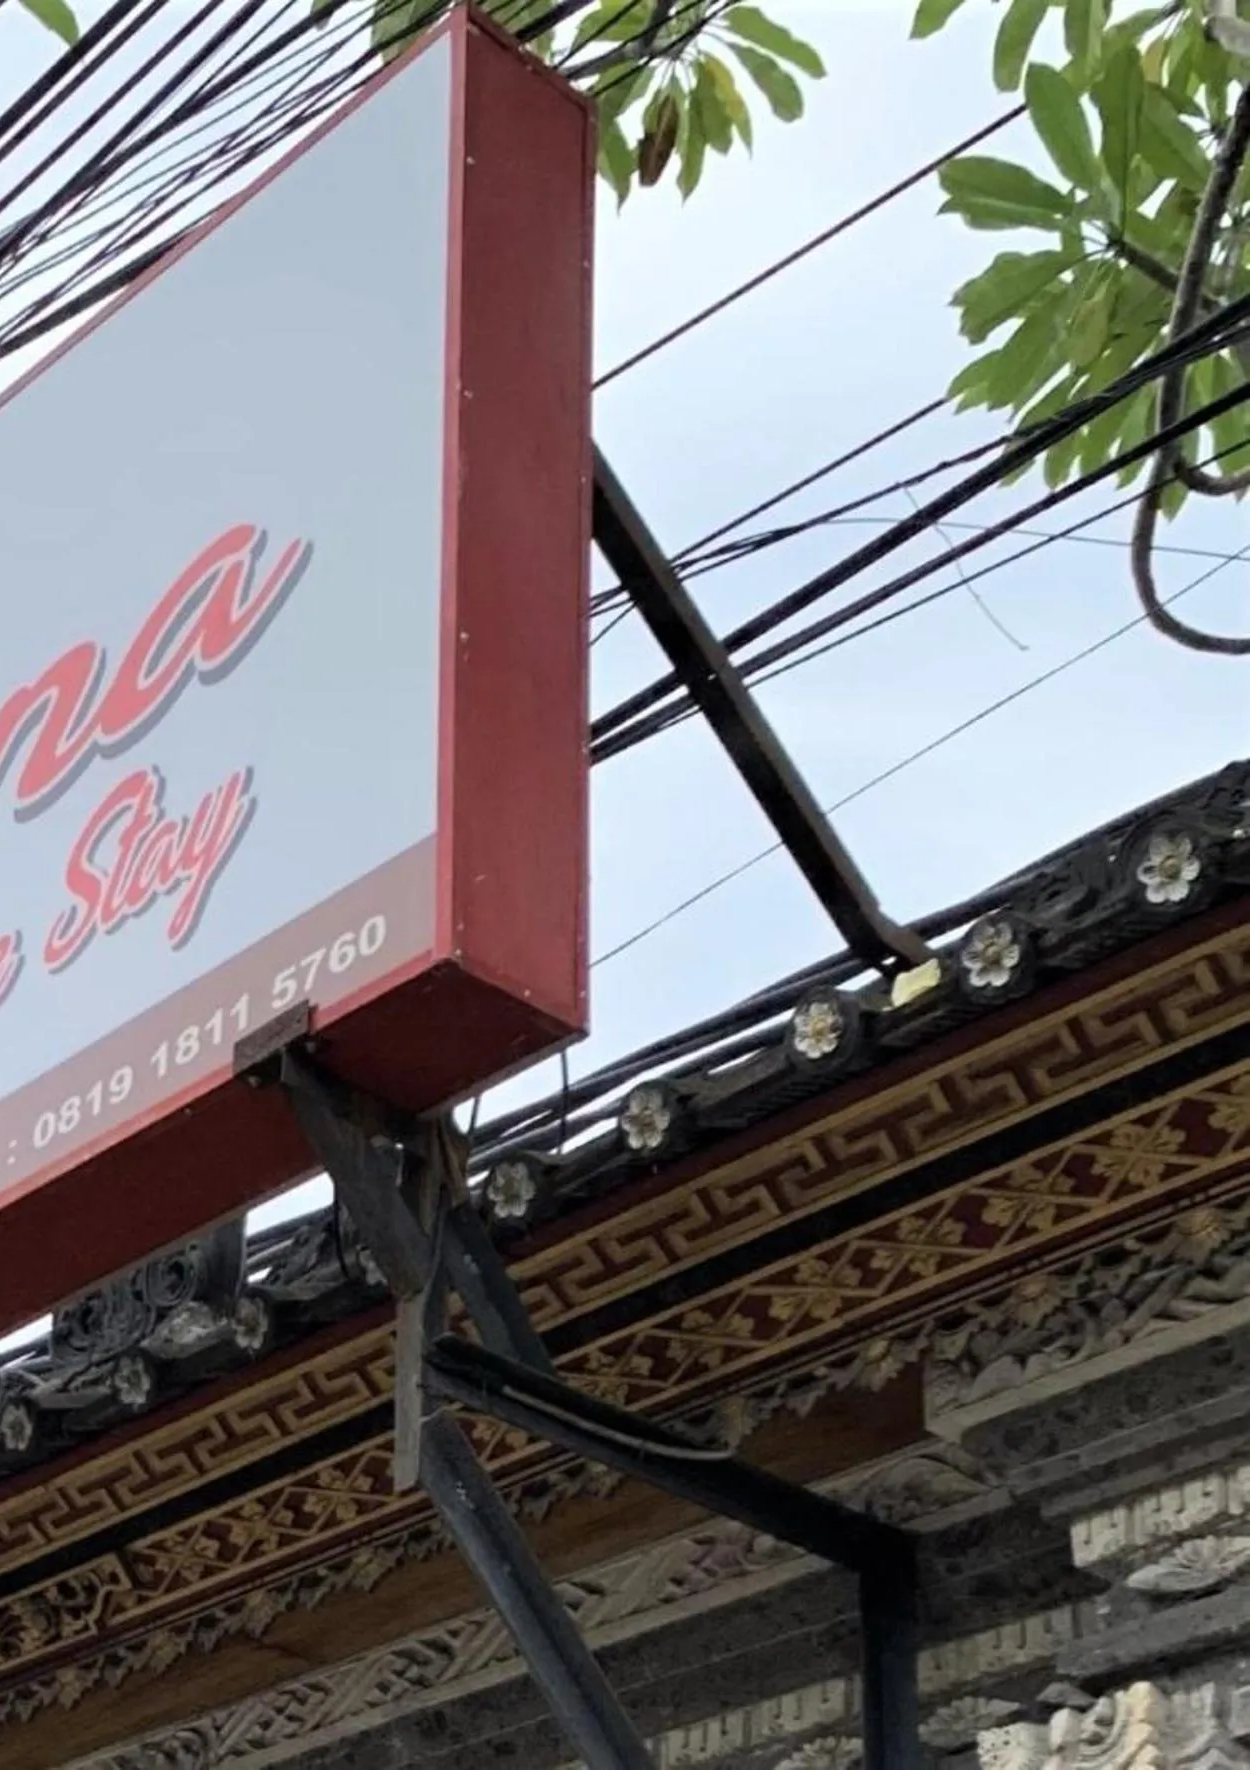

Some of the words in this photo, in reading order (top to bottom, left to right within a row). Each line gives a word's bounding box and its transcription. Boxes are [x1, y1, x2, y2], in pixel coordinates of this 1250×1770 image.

[43, 763, 257, 976] Stay
[32, 1065, 134, 1149] 0819
[151, 993, 250, 1079] 1811
[271, 914, 387, 1009] 5760
